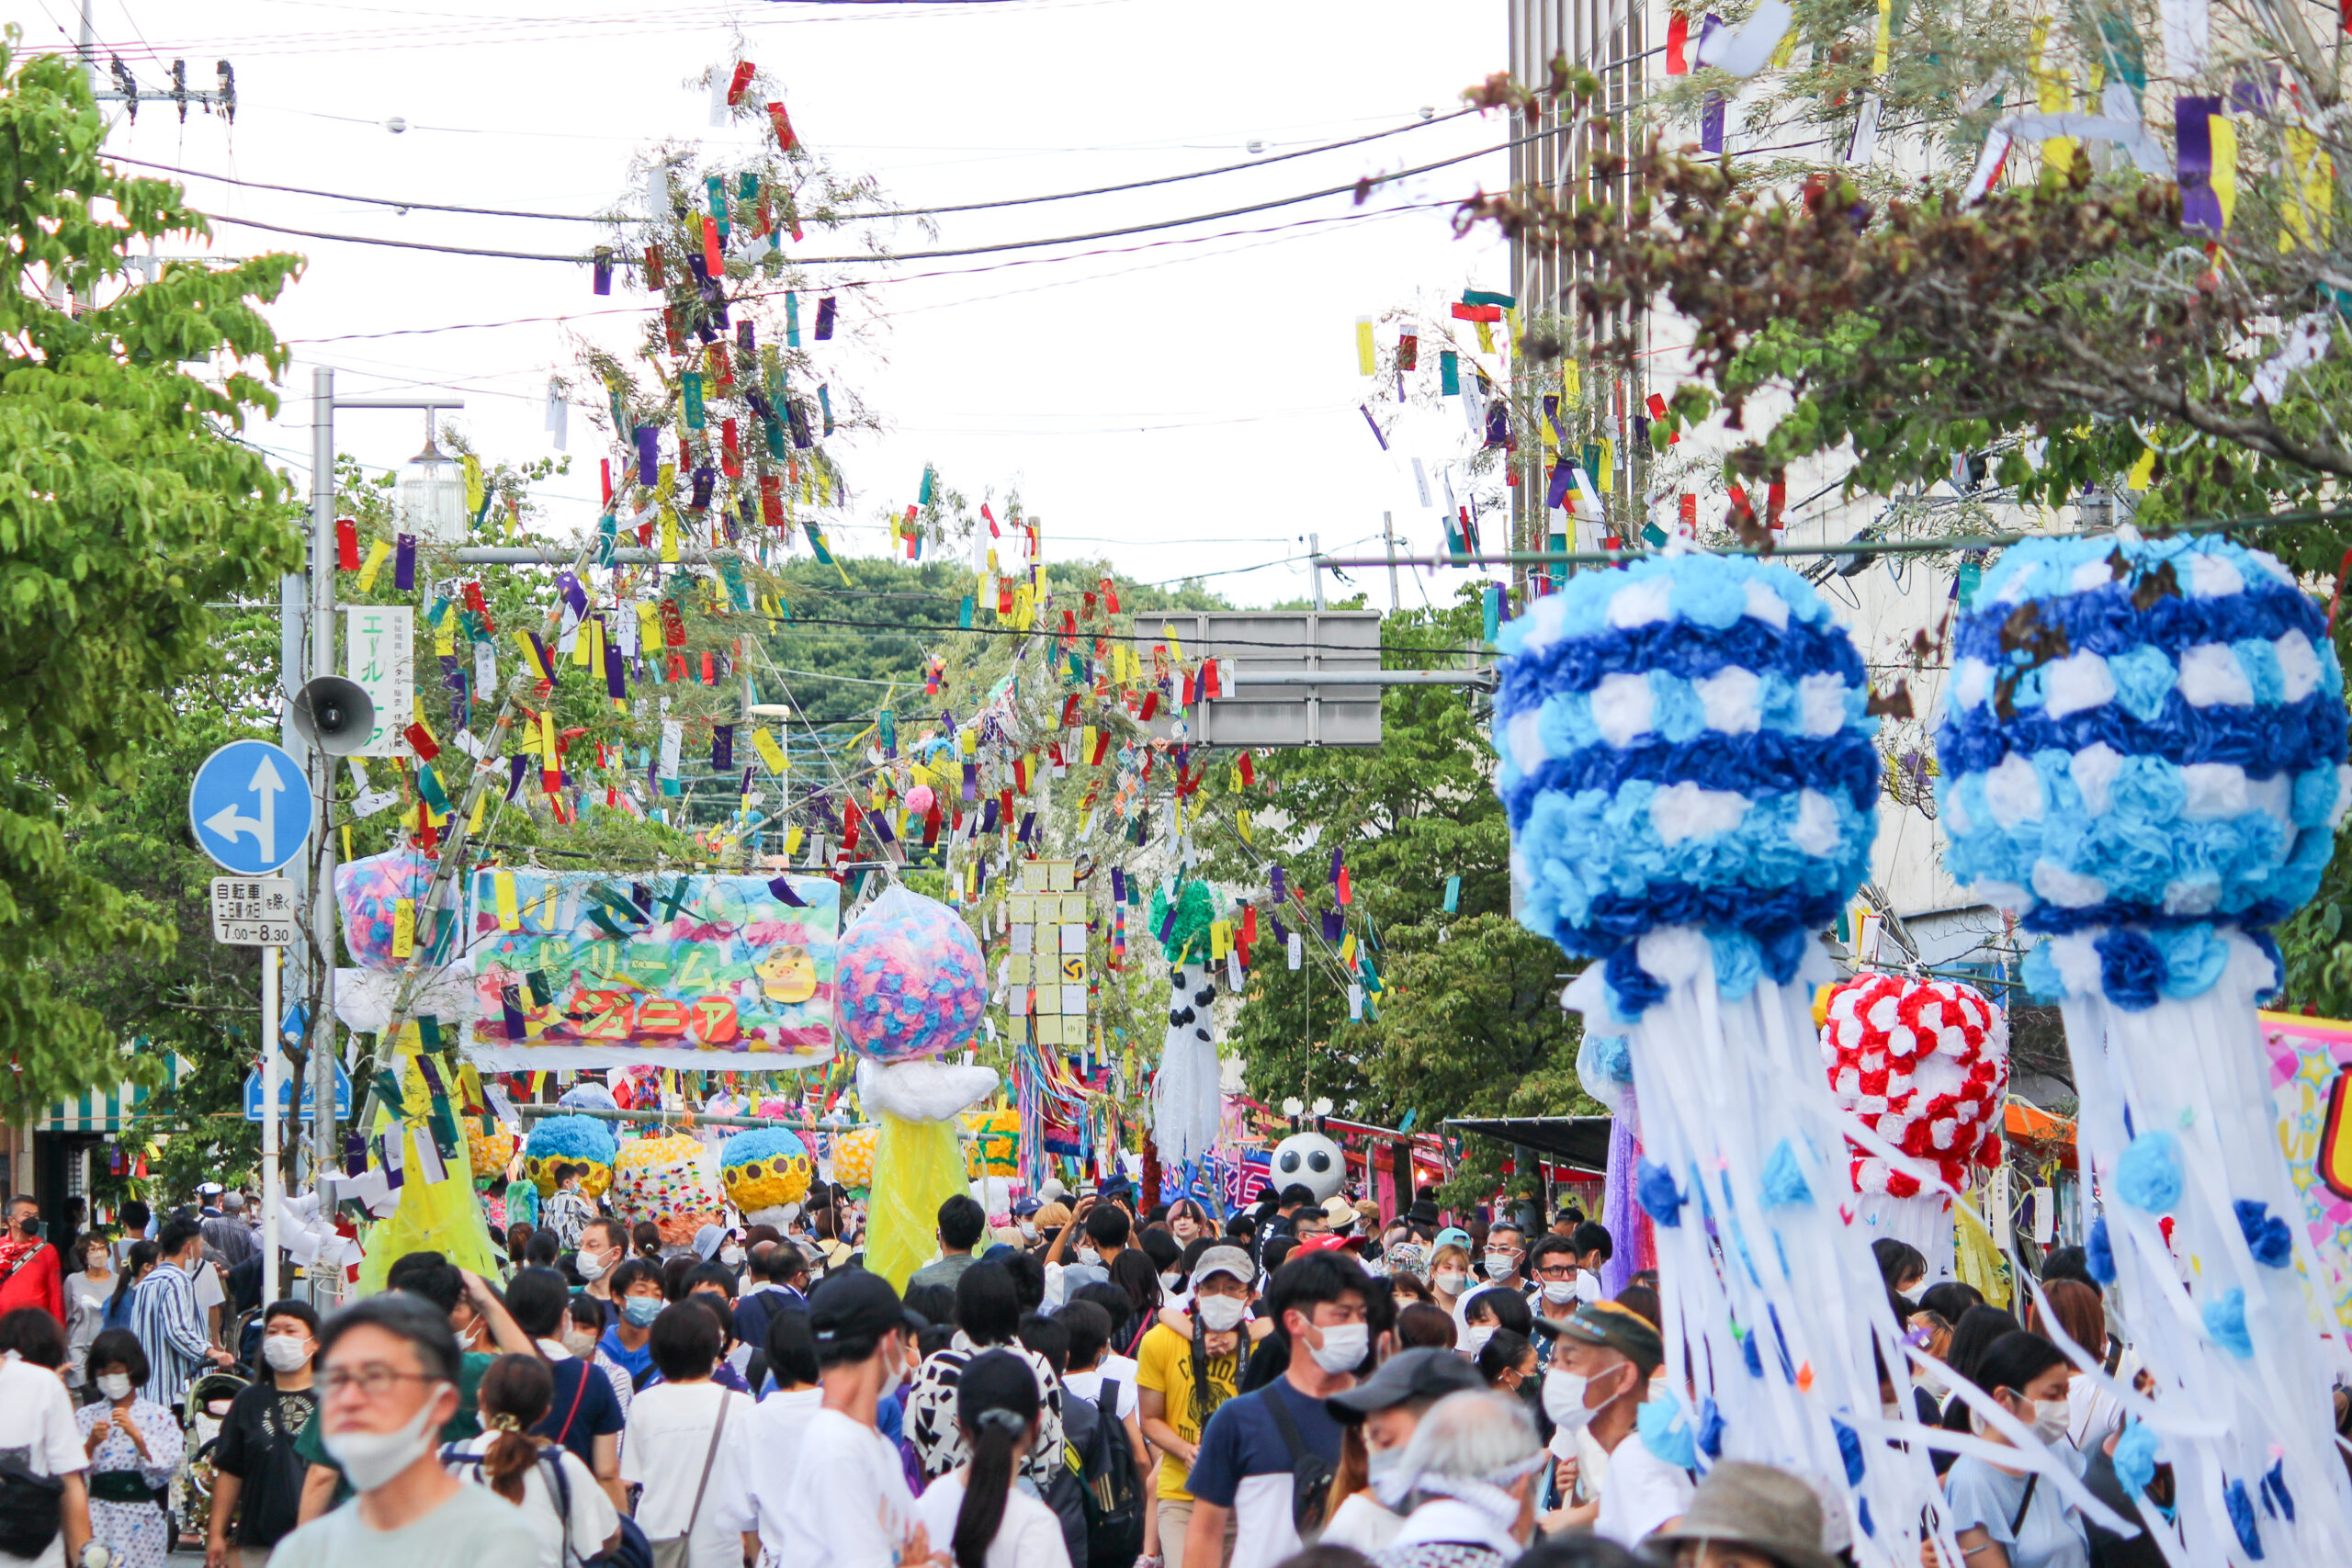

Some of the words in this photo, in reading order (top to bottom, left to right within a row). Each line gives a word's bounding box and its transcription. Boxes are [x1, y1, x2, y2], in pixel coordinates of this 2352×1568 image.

[217, 883, 260, 899] 自転車
[1027, 867, 1070, 886] 竹沢
[266, 893, 289, 910] を除く
[538, 940, 717, 993] ドリーム
[1040, 932, 1057, 1010] バレー
[576, 992, 737, 1042] ジュニア
